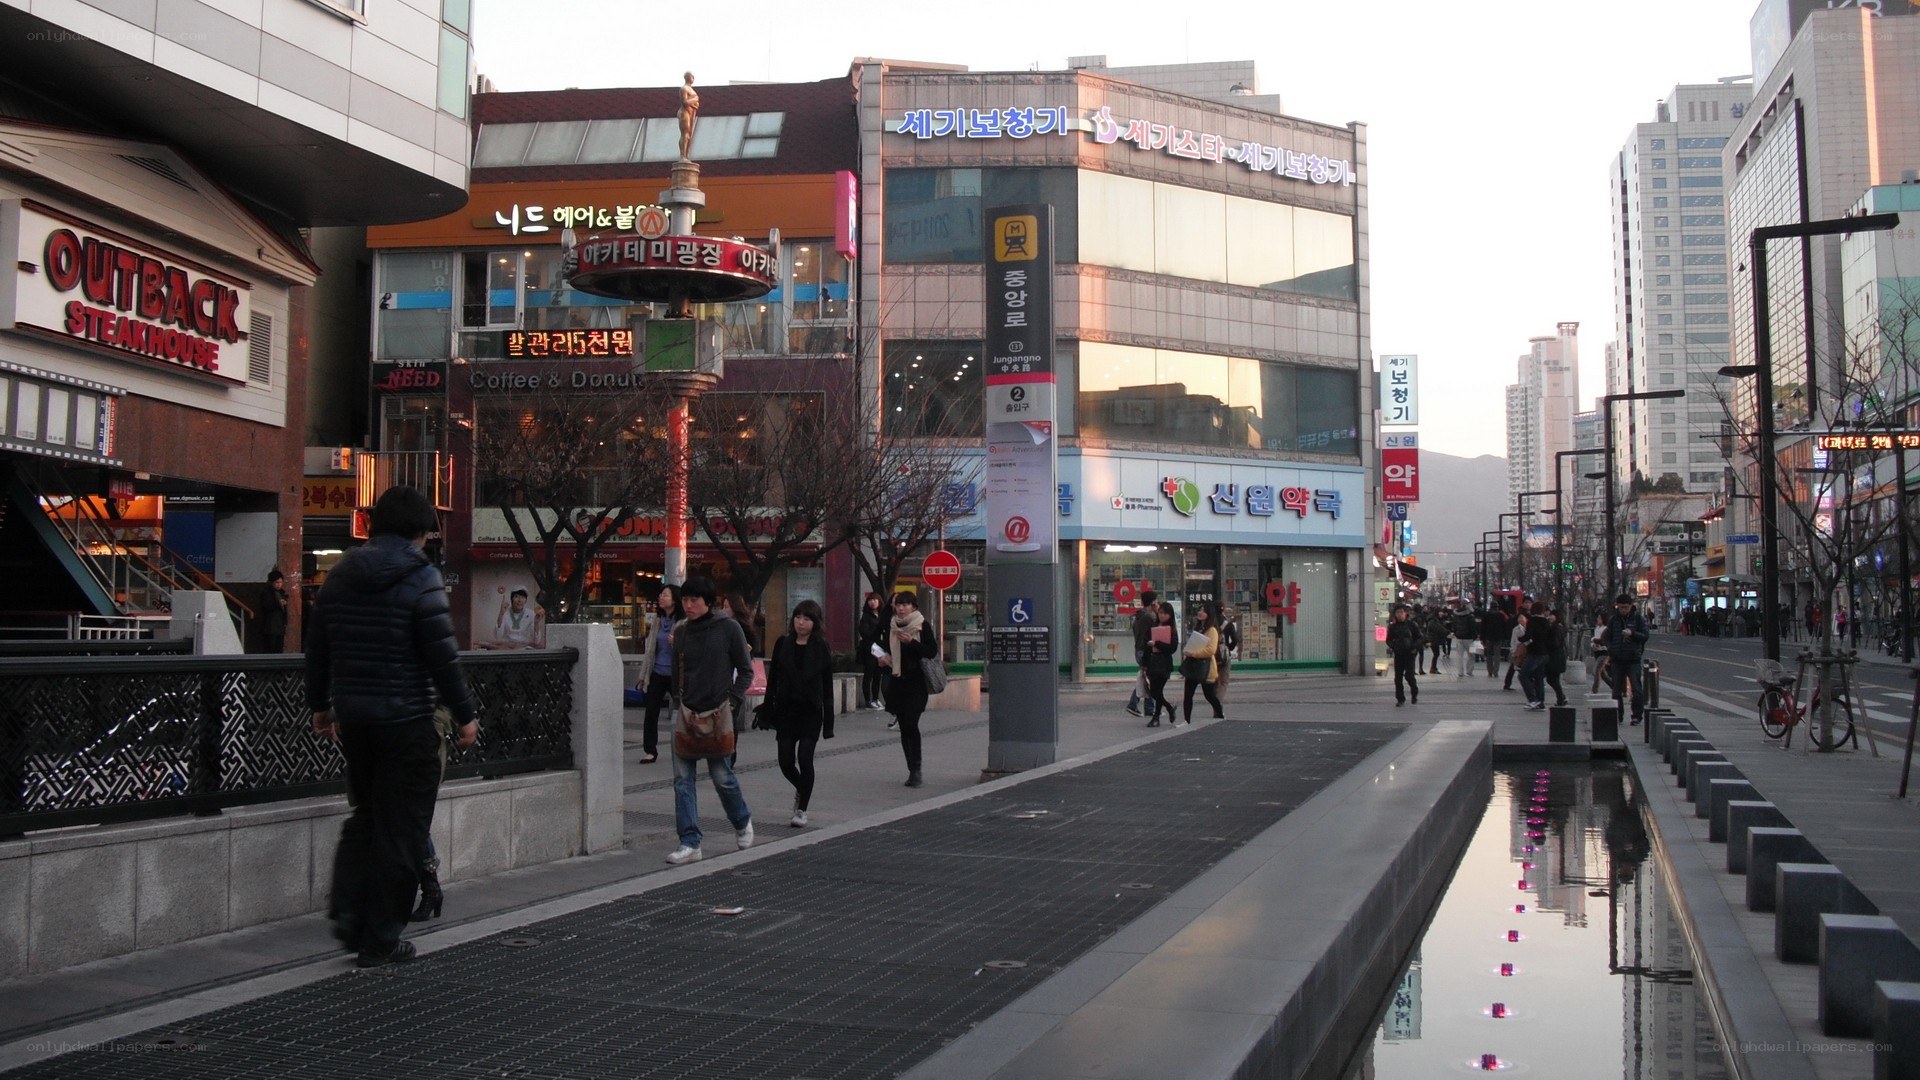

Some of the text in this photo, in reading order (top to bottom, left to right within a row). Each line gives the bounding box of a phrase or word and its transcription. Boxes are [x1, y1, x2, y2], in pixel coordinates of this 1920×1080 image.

[897, 106, 1068, 139] 세기보청기
[495, 204, 549, 236] 니드
[583, 241, 723, 266] 아카데미광장
[44, 229, 240, 343] OUTBACK
[1003, 270, 1028, 328] 중앙로
[64, 300, 219, 371] STEAKHOUSE
[993, 355, 1041, 365] Jungangno
[1001, 364, 1031, 373] 中央路
[1389, 358, 1408, 366] 세기
[386, 371, 442, 387] NEED
[470, 371, 541, 389] Coffee
[1391, 370, 1409, 421] 보청기
[1005, 403, 1030, 413] 출입구
[1385, 436, 1416, 448] 신원
[1384, 464, 1416, 488] 약
[1208, 483, 1342, 519] 신원약국
[1397, 505, 1405, 514] B
[944, 594, 978, 603] 신원약국
[1266, 581, 1302, 623] 약
